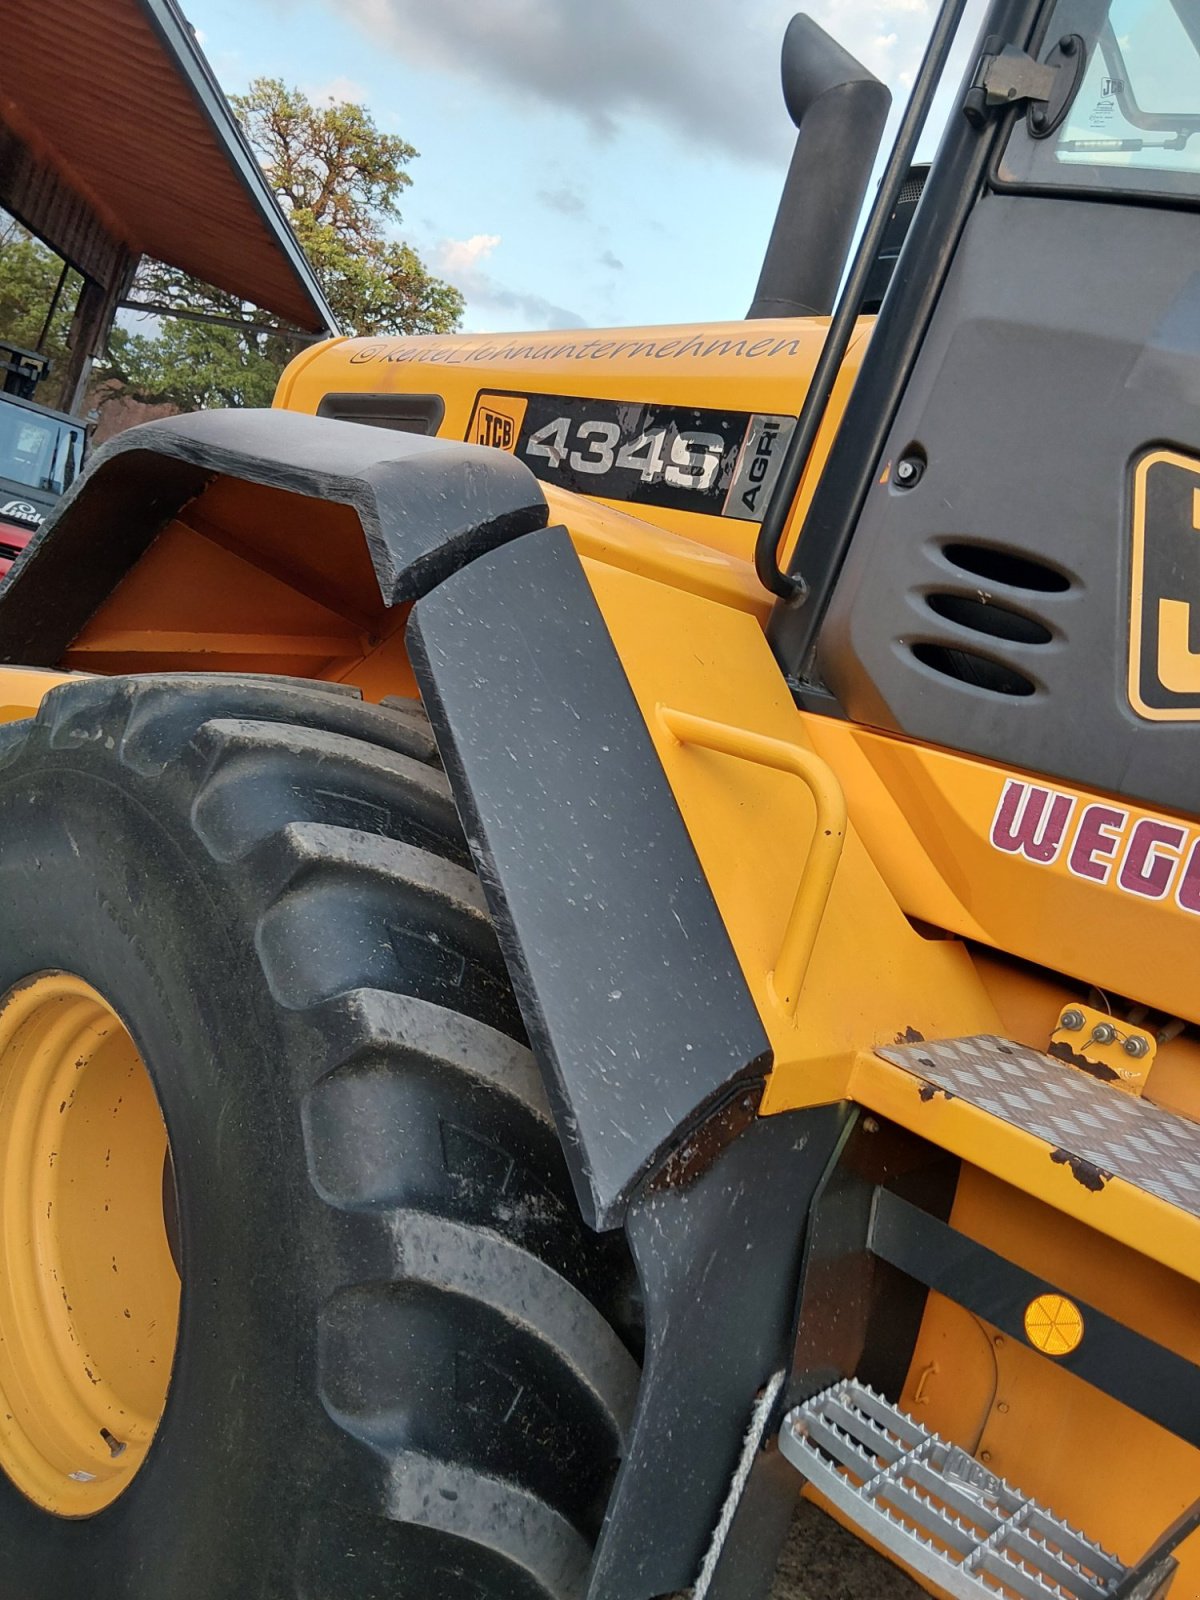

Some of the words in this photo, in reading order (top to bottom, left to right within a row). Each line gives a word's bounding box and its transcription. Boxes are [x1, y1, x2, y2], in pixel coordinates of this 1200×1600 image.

[1103, 79, 1124, 96] JCB
[479, 413, 512, 449] JCB
[525, 417, 725, 490] 434S
[741, 422, 781, 513] AGRI
